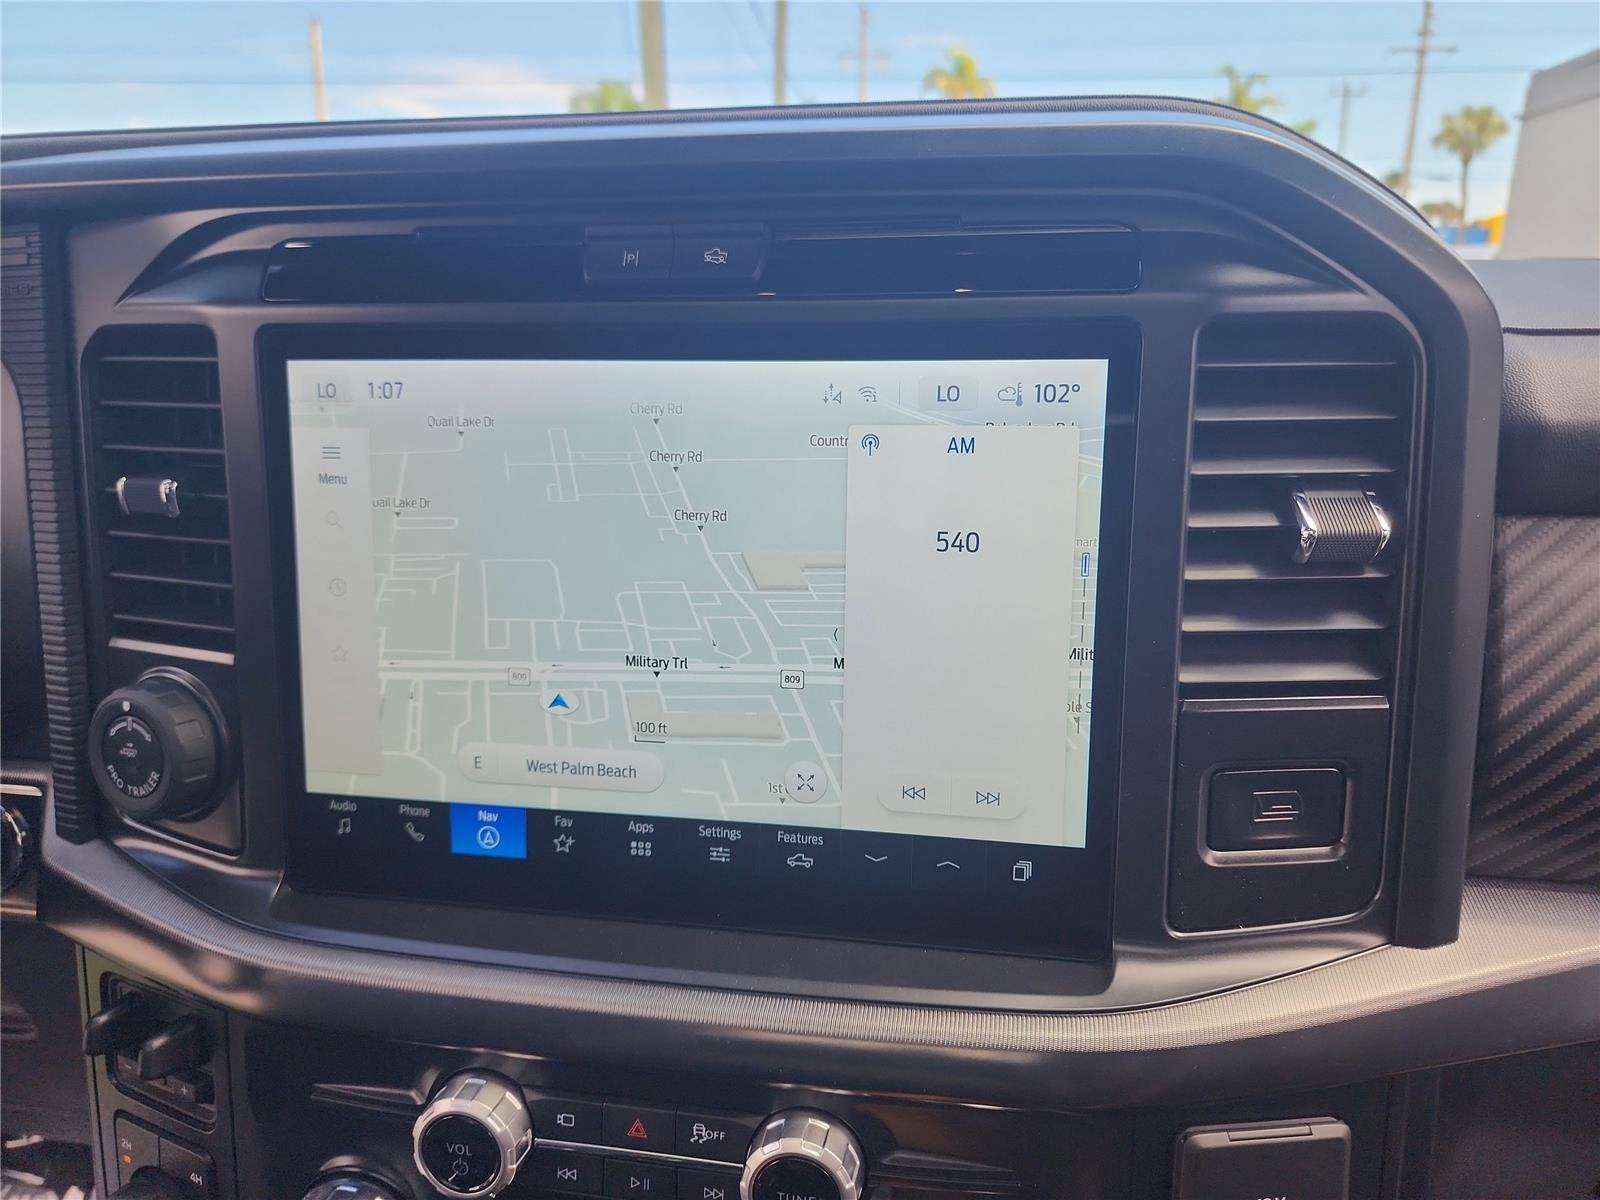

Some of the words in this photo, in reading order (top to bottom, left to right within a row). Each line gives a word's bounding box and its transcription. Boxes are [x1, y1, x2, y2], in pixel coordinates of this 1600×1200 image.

[317, 383, 337, 399] LO
[367, 382, 404, 399] 1:07
[936, 385, 960, 402] LO
[1034, 383, 1081, 403] 102°
[630, 403, 665, 416] Cherry
[667, 403, 683, 415] Rd
[426, 415, 455, 429] Quail
[456, 416, 482, 428] Lake
[484, 416, 496, 428] Dr
[947, 437, 976, 454] AM
[649, 451, 685, 464] Cherry
[687, 451, 703, 463] Rd
[318, 473, 348, 485] Menu
[393, 497, 417, 508] Lake
[419, 498, 431, 508] Dr
[674, 509, 710, 522] Cherry
[712, 510, 727, 522] Rd
[936, 531, 981, 553] 540
[625, 655, 669, 671] Military
[672, 657, 688, 669] Trl
[784, 675, 801, 684] 809
[636, 722, 655, 734] 100
[657, 722, 668, 734] ft
[474, 756, 482, 769] E
[526, 759, 558, 774] West
[560, 761, 594, 777] Palm
[597, 763, 637, 778] Beach
[106, 764, 125, 789] PRO
[127, 770, 161, 797] TRAILER
[768, 782, 783, 794] 1st
[329, 799, 358, 812] Audio
[399, 803, 431, 817] Phone
[477, 810, 499, 823] Nav
[554, 816, 574, 828] Fav
[628, 821, 655, 834] Apps
[698, 825, 742, 841] Settings
[777, 831, 824, 846] Features
[705, 1130, 726, 1141] OFF
[446, 1142, 473, 1156] VOL
